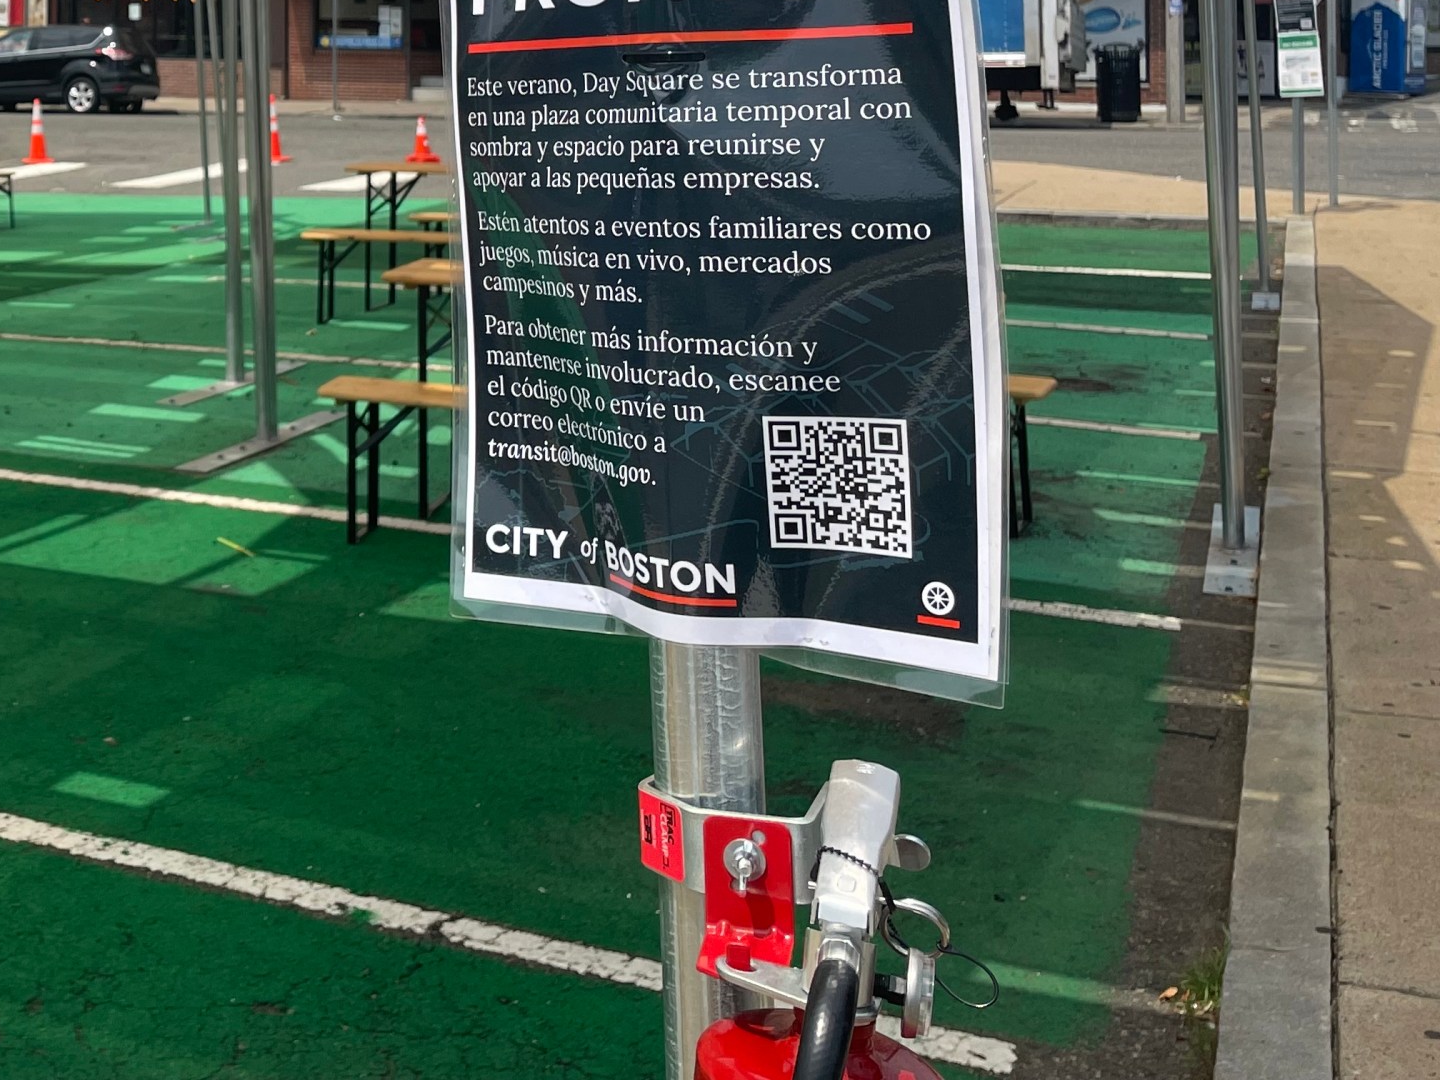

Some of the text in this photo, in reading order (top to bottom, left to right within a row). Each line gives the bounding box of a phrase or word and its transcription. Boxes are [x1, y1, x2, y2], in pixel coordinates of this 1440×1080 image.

[468, 64, 902, 99] Este verano, Day Square se transforma
[468, 97, 912, 132] en una plaza comunitaria temporal con
[470, 133, 825, 163] sombra y espacio para reunirse y
[473, 166, 819, 195] apoyar a las pequeñas empresas.
[478, 211, 931, 240] Estén atentos a eventos familiares como
[479, 241, 831, 276] juegos, música en vivo, mercados
[483, 275, 642, 306] campesinos y más.
[485, 315, 817, 365] Para obtener más información y
[487, 350, 840, 393] mantenerse involucrado, escanee
[488, 375, 705, 422] el código QR o envíe un
[488, 411, 666, 453] correo electrónico a
[488, 439, 656, 487] transit@boston.gov.
[486, 522, 735, 594] CITY of BOSTON
